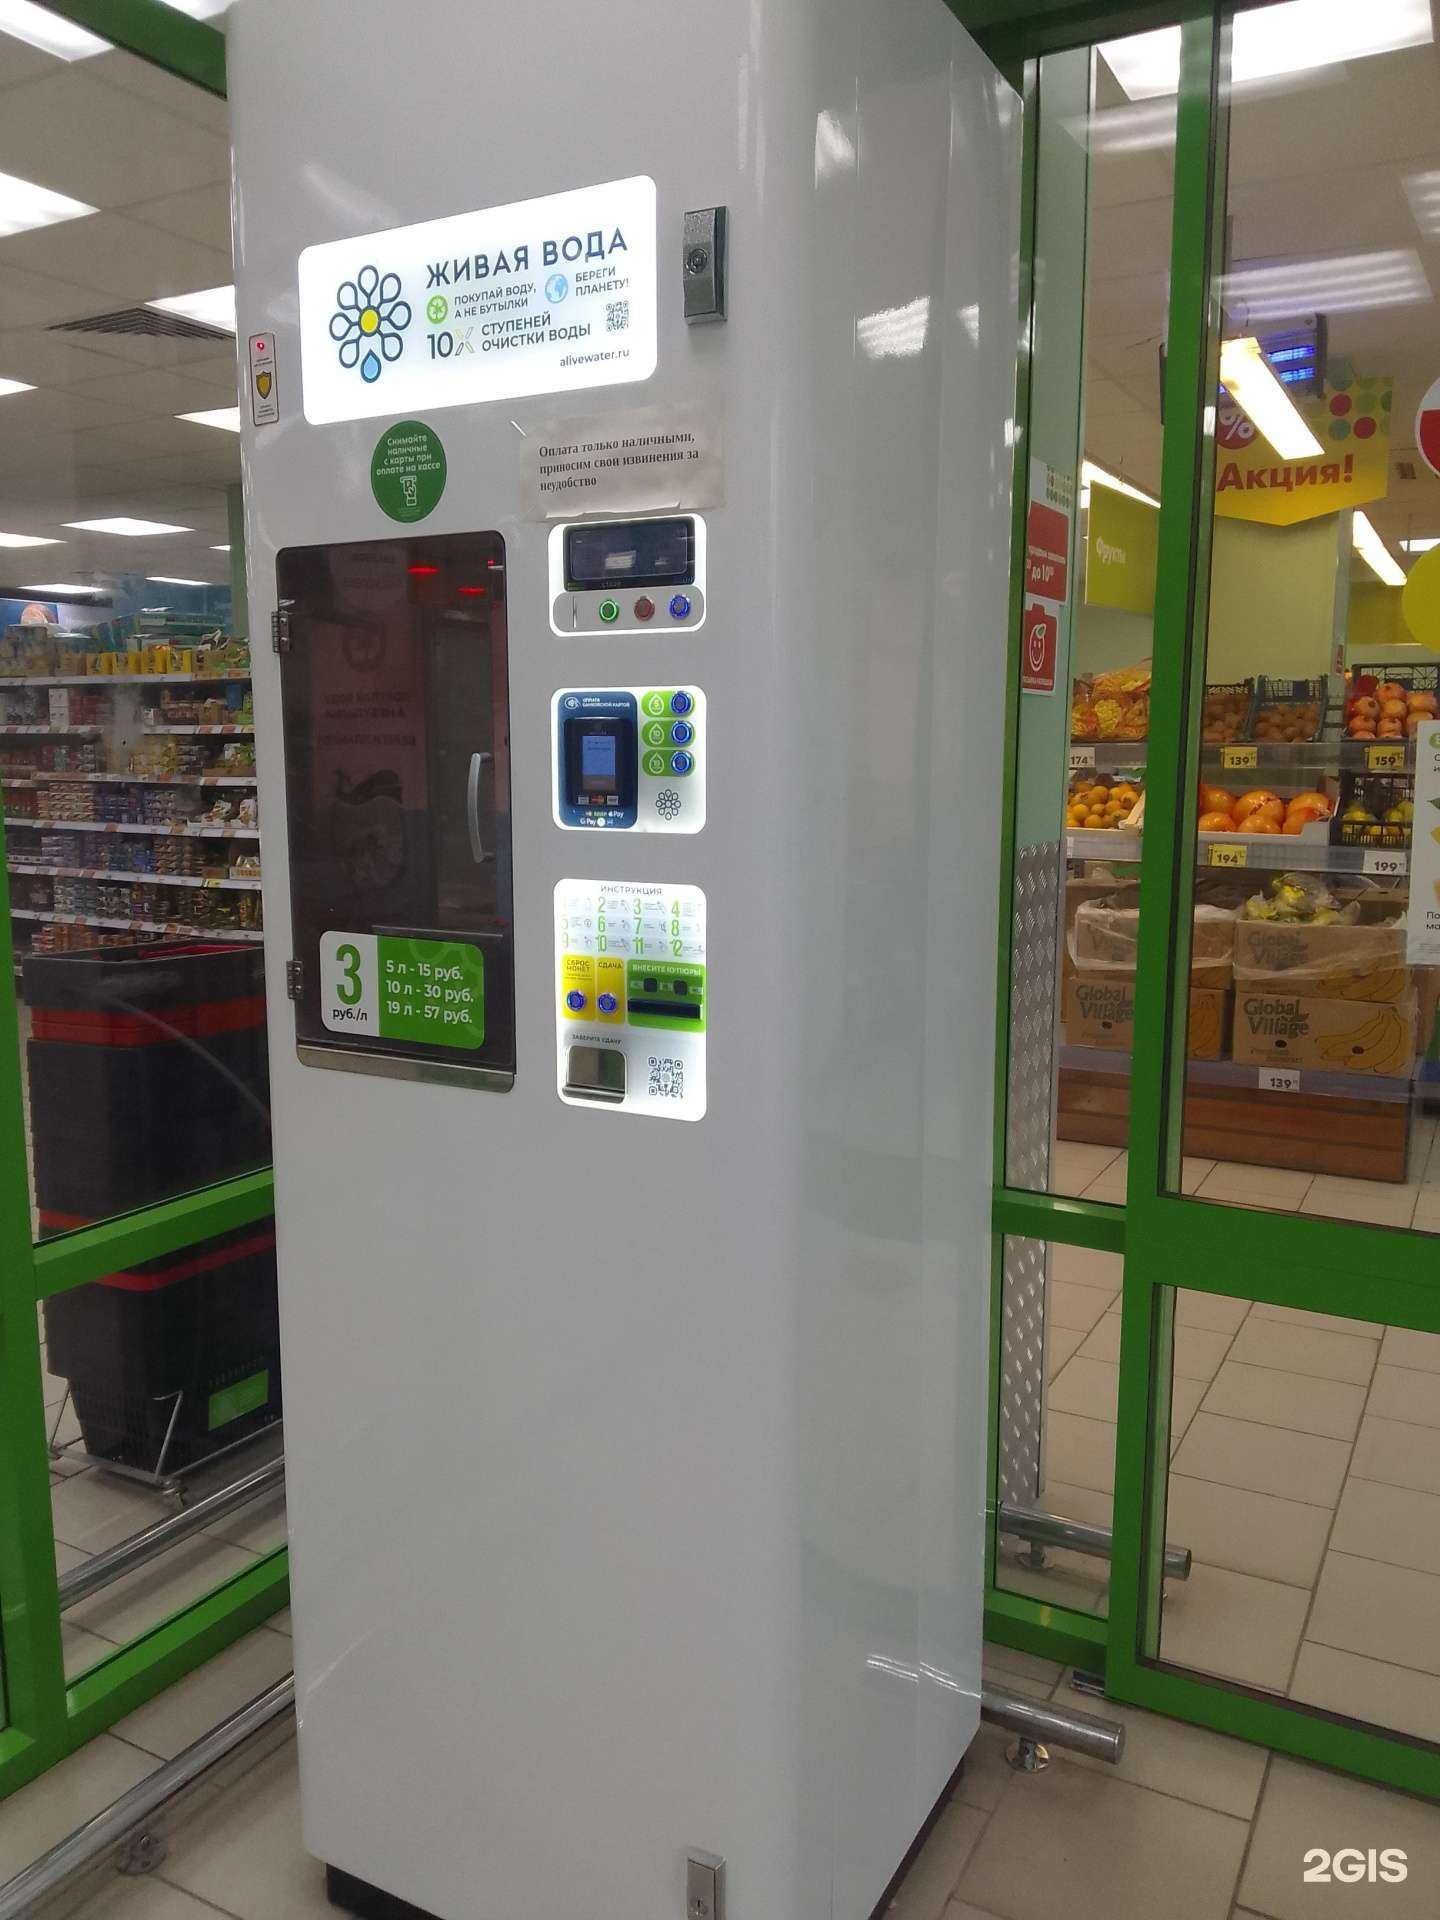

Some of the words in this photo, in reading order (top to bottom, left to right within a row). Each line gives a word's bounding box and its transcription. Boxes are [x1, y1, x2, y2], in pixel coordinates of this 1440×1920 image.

[426, 245, 529, 288] ЖИВАЯ
[543, 227, 628, 266] ВОДА
[575, 266, 616, 283] БЕРЕГИ
[454, 286, 503, 306] ПОКУПАЙ
[505, 282, 537, 297] ВОДУ,
[575, 279, 630, 297] ПЛАНЕТУ!
[454, 310, 462, 319] А
[464, 305, 477, 317] НЕ
[479, 298, 529, 315] БУТЫЛКИ
[481, 312, 551, 336] СТУПЕНЕЙ
[481, 331, 545, 352] ОЧИСТКИ
[549, 323, 591, 342] ВОДЫ
[559, 349, 630, 367] alivewater.ru
[387, 445, 428, 456] наличные
[539, 445, 579, 458] Оплата
[582, 440, 619, 453] только
[622, 432, 695, 448] наличными,
[539, 461, 591, 476] приносим
[594, 458, 620, 468] свои
[622, 452, 684, 467] извинения
[687, 449, 699, 459] за
[1216, 454, 1354, 492] Акция!
[540, 476, 597, 493] неудобство
[1070, 756, 1088, 765] 174
[1229, 756, 1250, 765] 139
[1375, 756, 1396, 766] 159
[1216, 853, 1238, 864] 194
[1374, 861, 1398, 871] 199
[600, 885, 663, 896] ИНСТРУКЦИЯ
[598, 896, 606, 913] 2
[633, 898, 642, 915] 3
[671, 900, 680, 918] 4
[598, 916, 606, 932] 6
[633, 917, 642, 934] 7
[671, 919, 680, 936] 8
[595, 935, 607, 952] 10
[632, 937, 644, 954] 11
[336, 943, 363, 1005] 3
[386, 960, 394, 973] 5
[398, 964, 406, 974] л
[418, 963, 431, 977] 15
[434, 966, 464, 982] руб.
[385, 980, 400, 994] 10
[403, 985, 412, 995] л
[424, 984, 441, 998] 30
[445, 988, 474, 1004] руб.
[1076, 982, 1126, 1001] Global
[332, 1007, 368, 1022] руб./л
[386, 1001, 400, 1014] 19
[403, 1005, 412, 1016] л
[424, 1005, 439, 1020] 57
[444, 1009, 473, 1025] руб.
[1243, 998, 1300, 1016] Global
[1248, 1013, 1309, 1038] Village
[1270, 1077, 1292, 1088] 139
